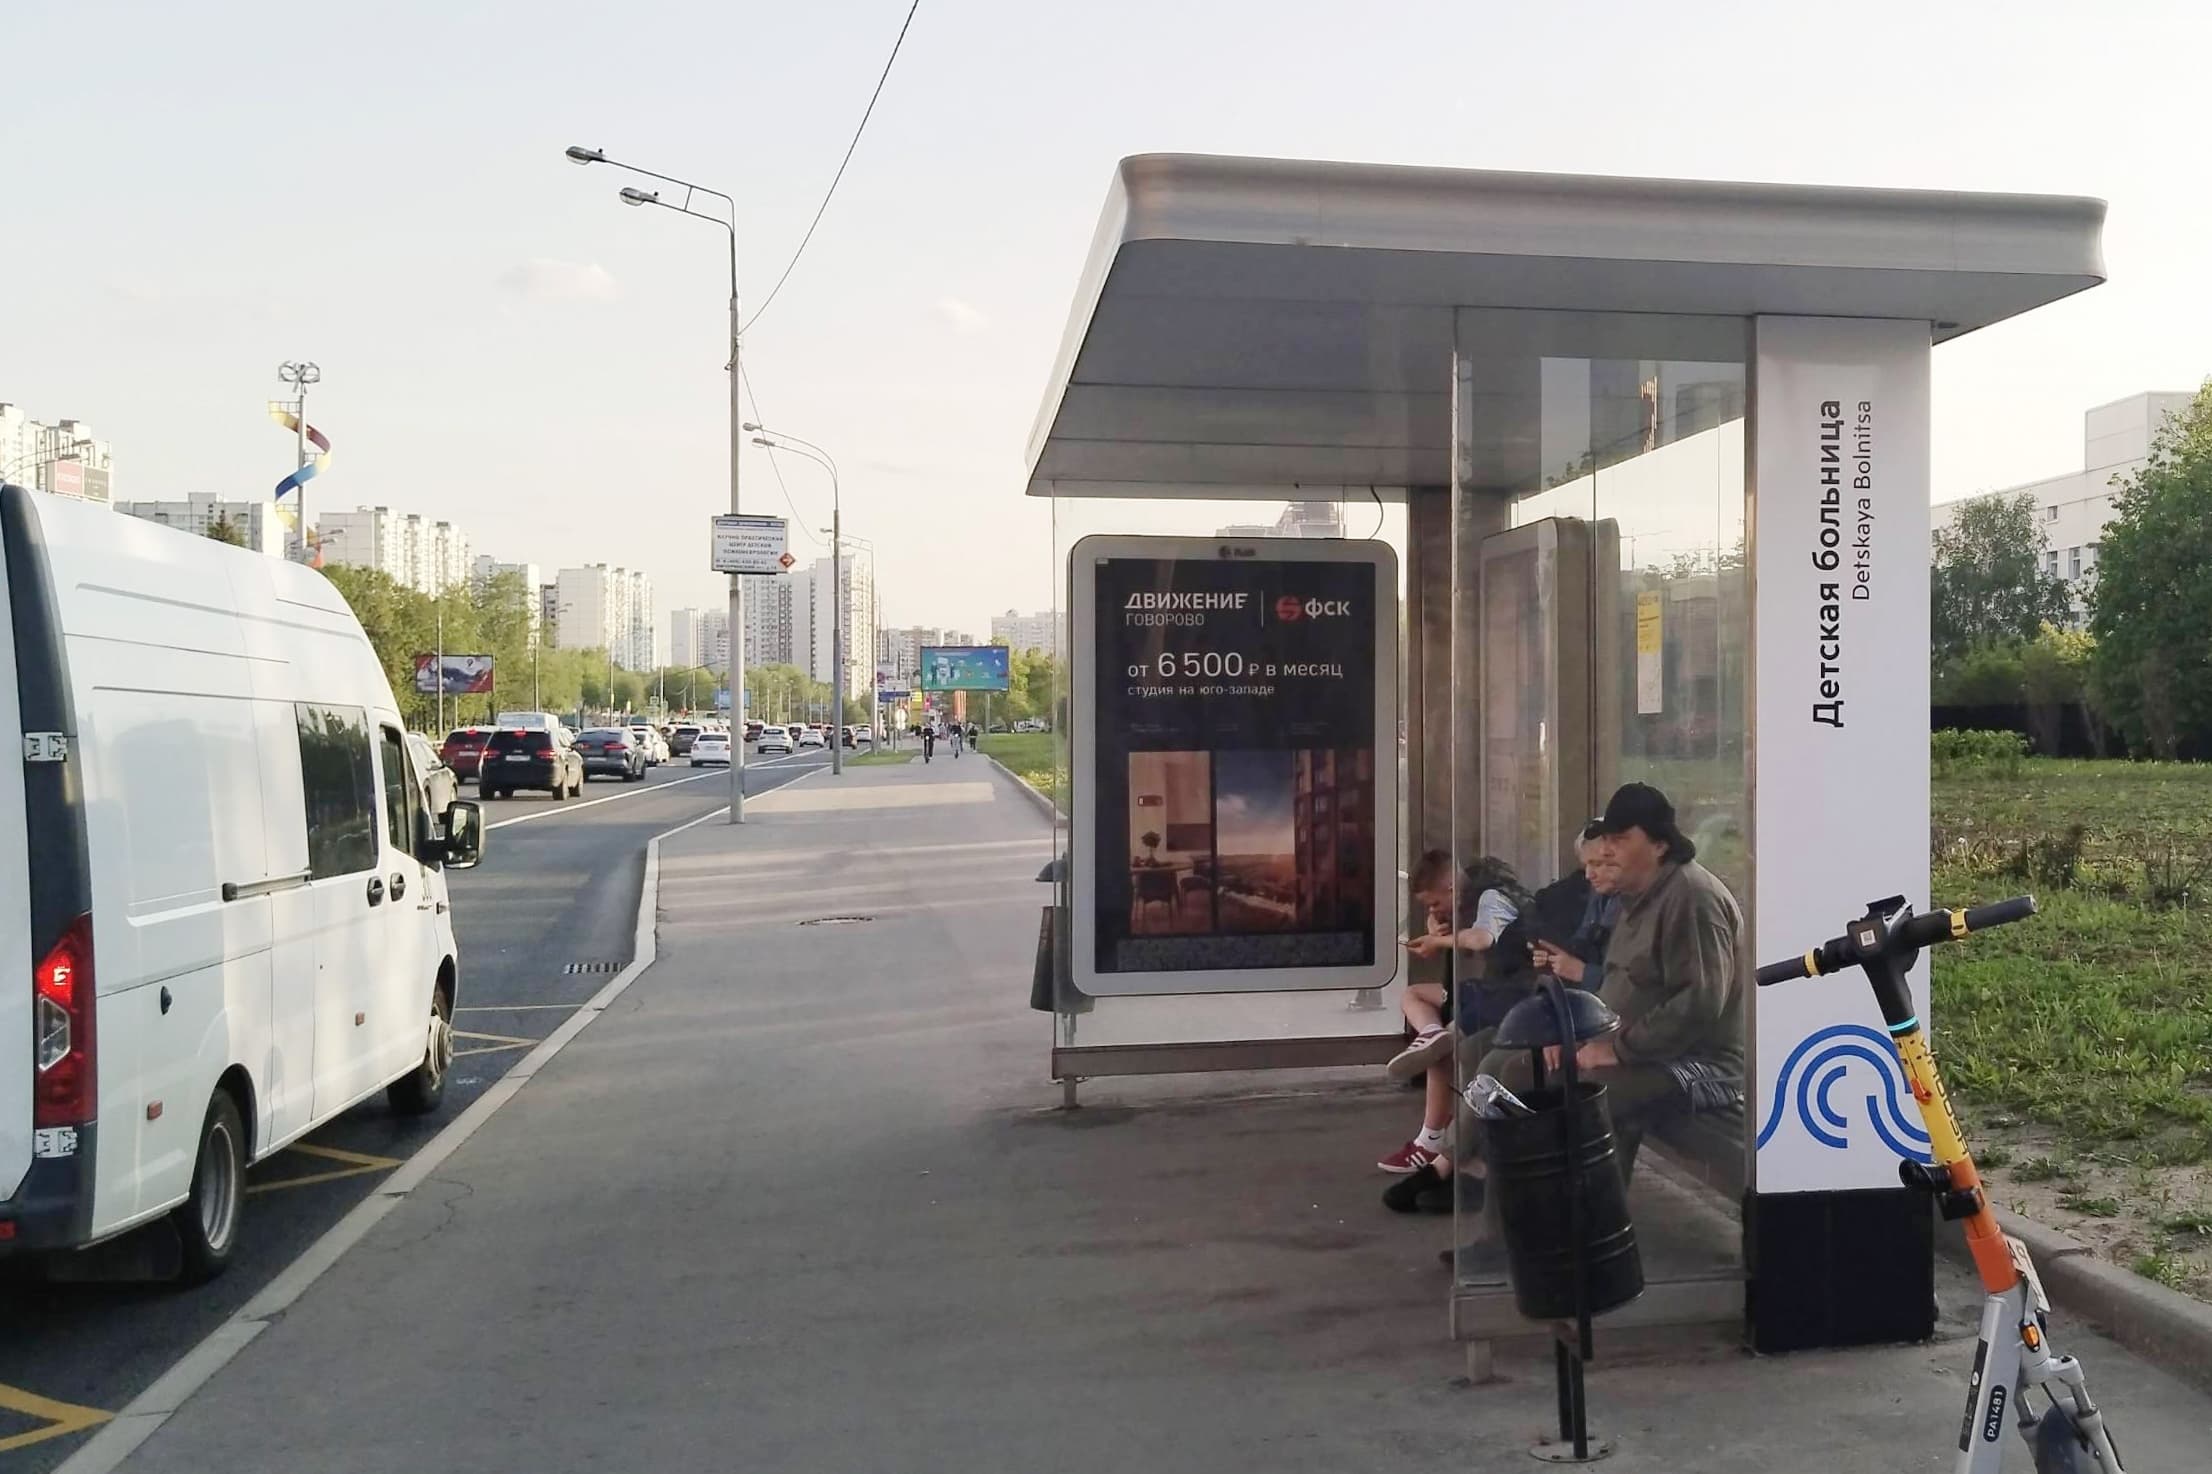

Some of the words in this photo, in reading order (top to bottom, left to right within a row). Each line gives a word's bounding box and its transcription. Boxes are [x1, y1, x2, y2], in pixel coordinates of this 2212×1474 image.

[1852, 401, 1872, 489] Bolnitsa
[1812, 400, 1845, 571] больница
[1852, 498, 1876, 600] Detskaya
[1124, 592, 1248, 609] ДВИЖЕНИЕ
[1305, 598, 1350, 619] ФСК
[1126, 613, 1205, 626] ГОВОРОВО
[1812, 582, 1845, 728] Детская
[1128, 665, 1149, 677] от
[1266, 666, 1277, 676] в
[1283, 664, 1343, 678] месяц
[1127, 686, 1174, 698] студия
[1179, 686, 1194, 695] на
[1200, 685, 1275, 697] юго-западе
